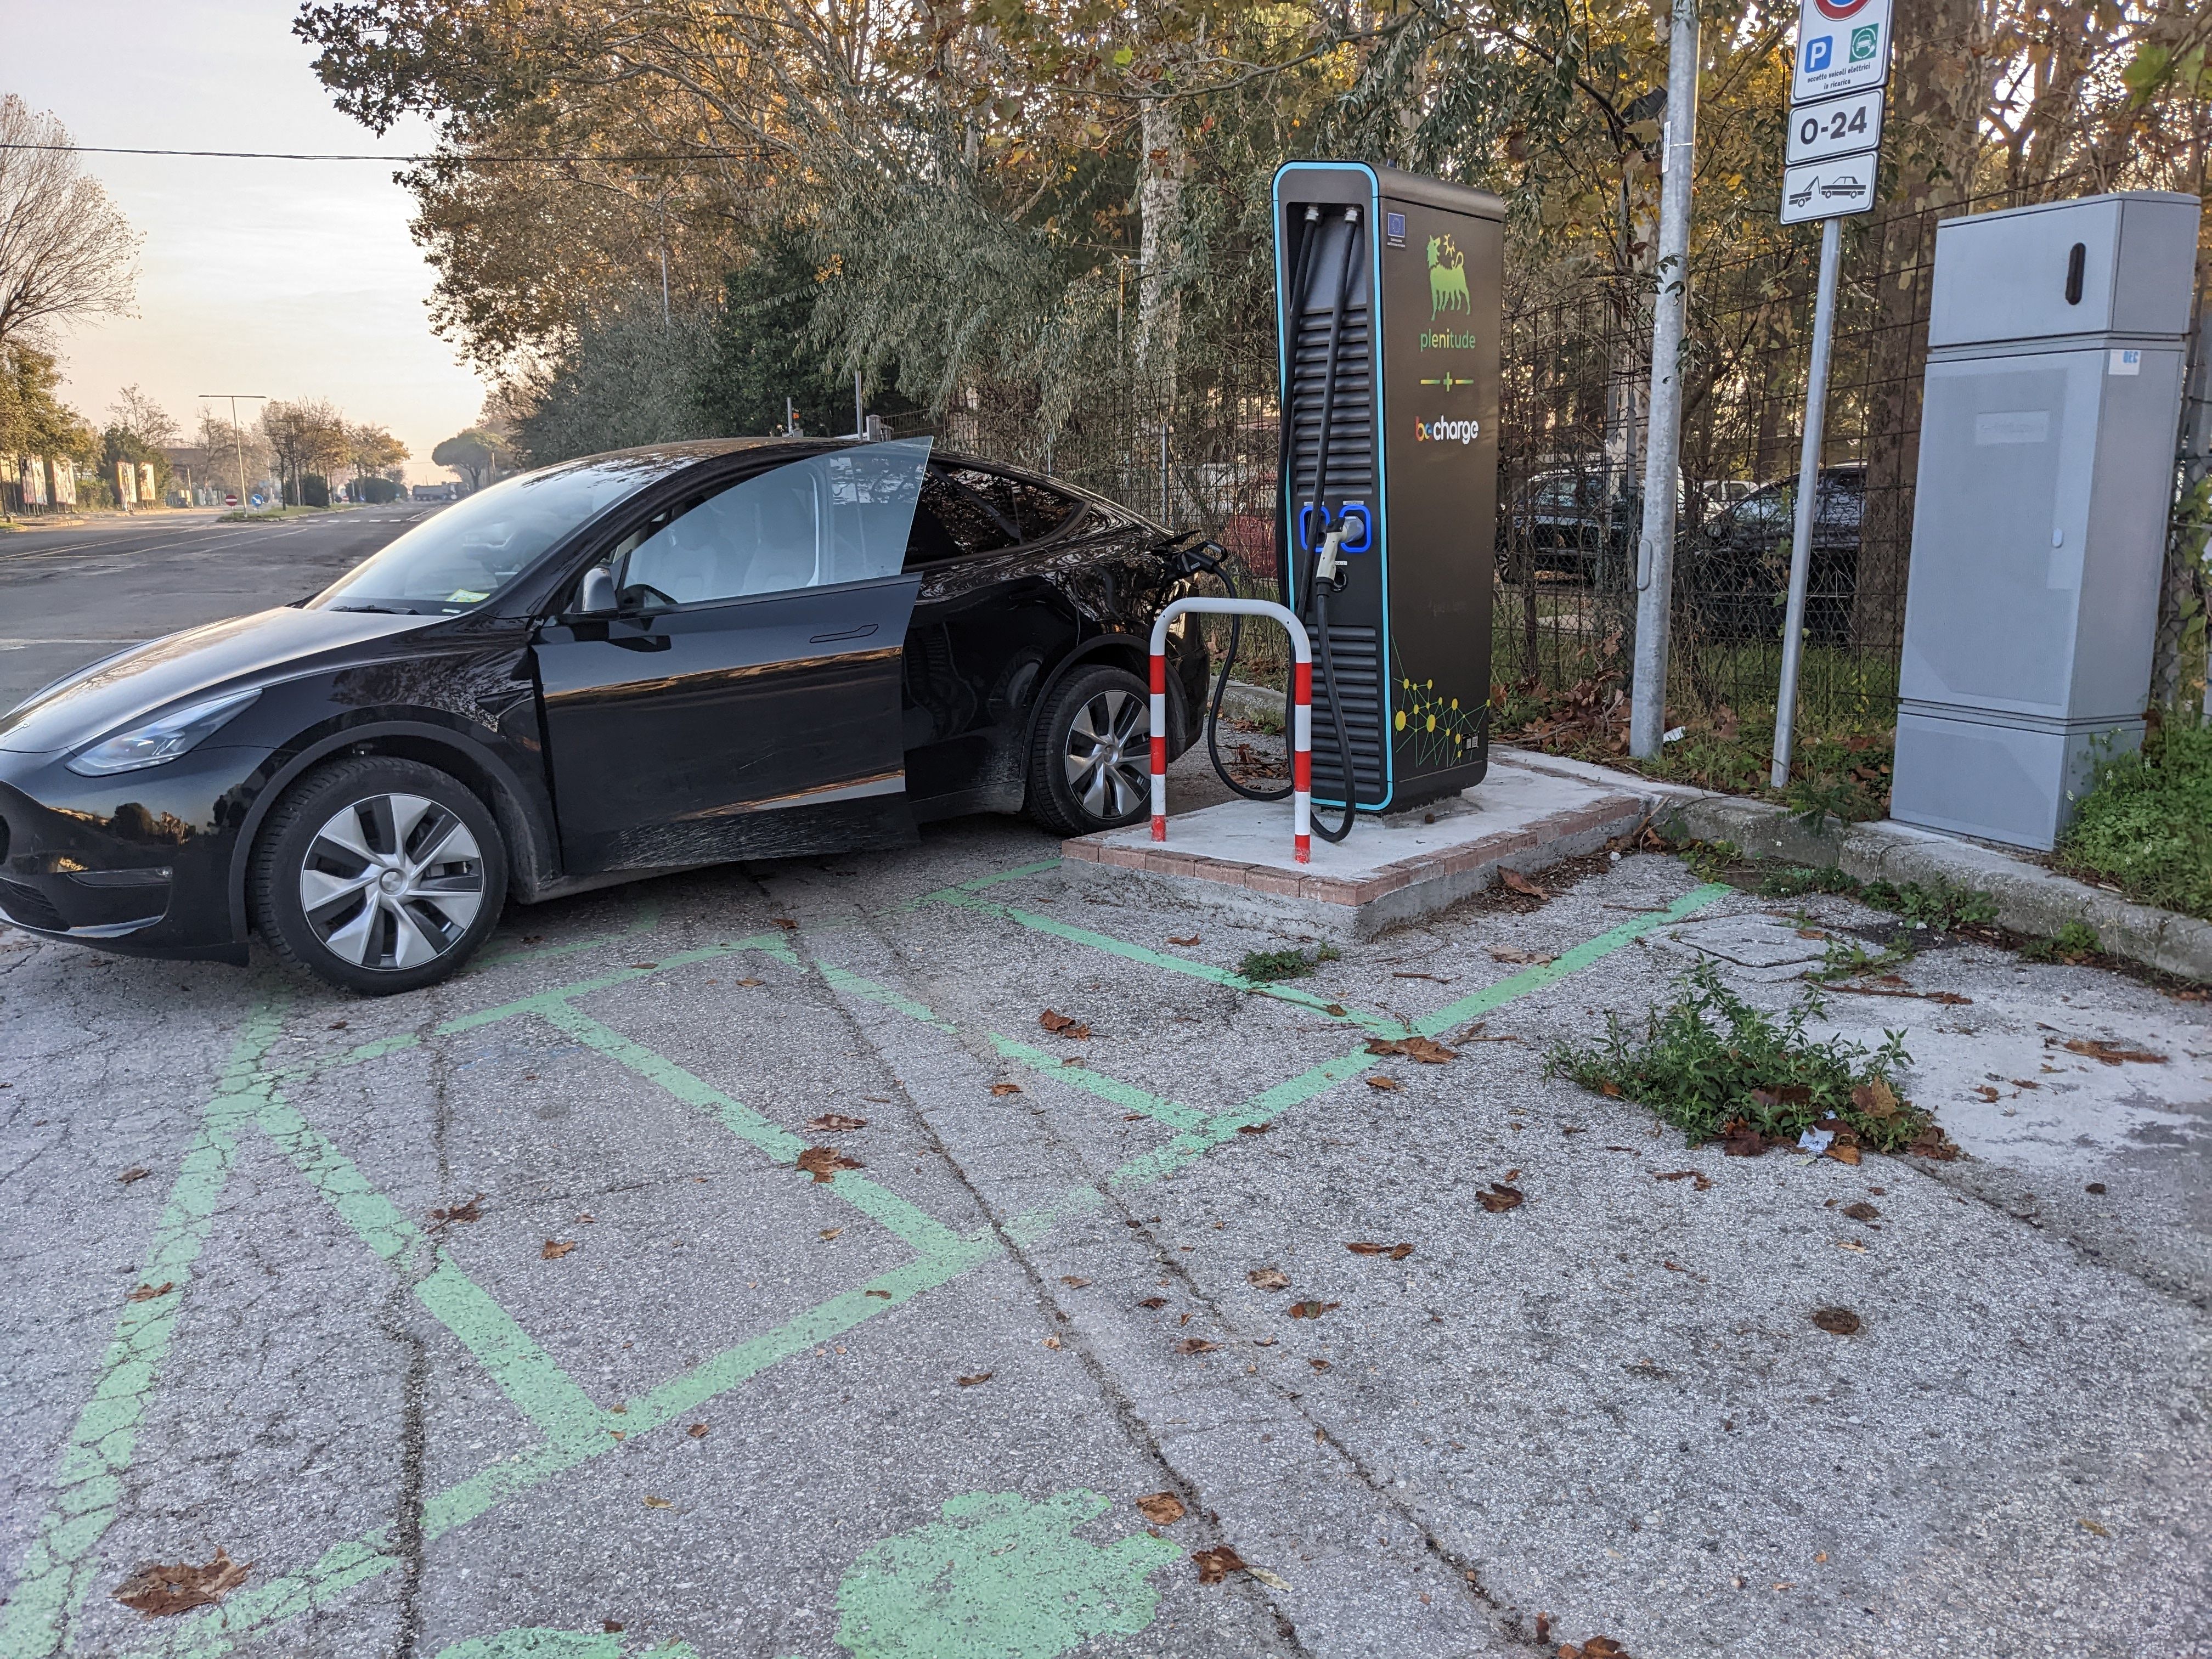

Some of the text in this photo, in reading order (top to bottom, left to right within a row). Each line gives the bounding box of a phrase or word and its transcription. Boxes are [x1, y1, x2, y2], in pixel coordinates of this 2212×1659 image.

[1810, 42, 1826, 69] P
[1807, 63, 1871, 83] eccetto veicoli elettrici
[1830, 79, 1851, 88] ricarica
[1800, 106, 1867, 145] 0-24
[1420, 328, 1476, 353] plenitude
